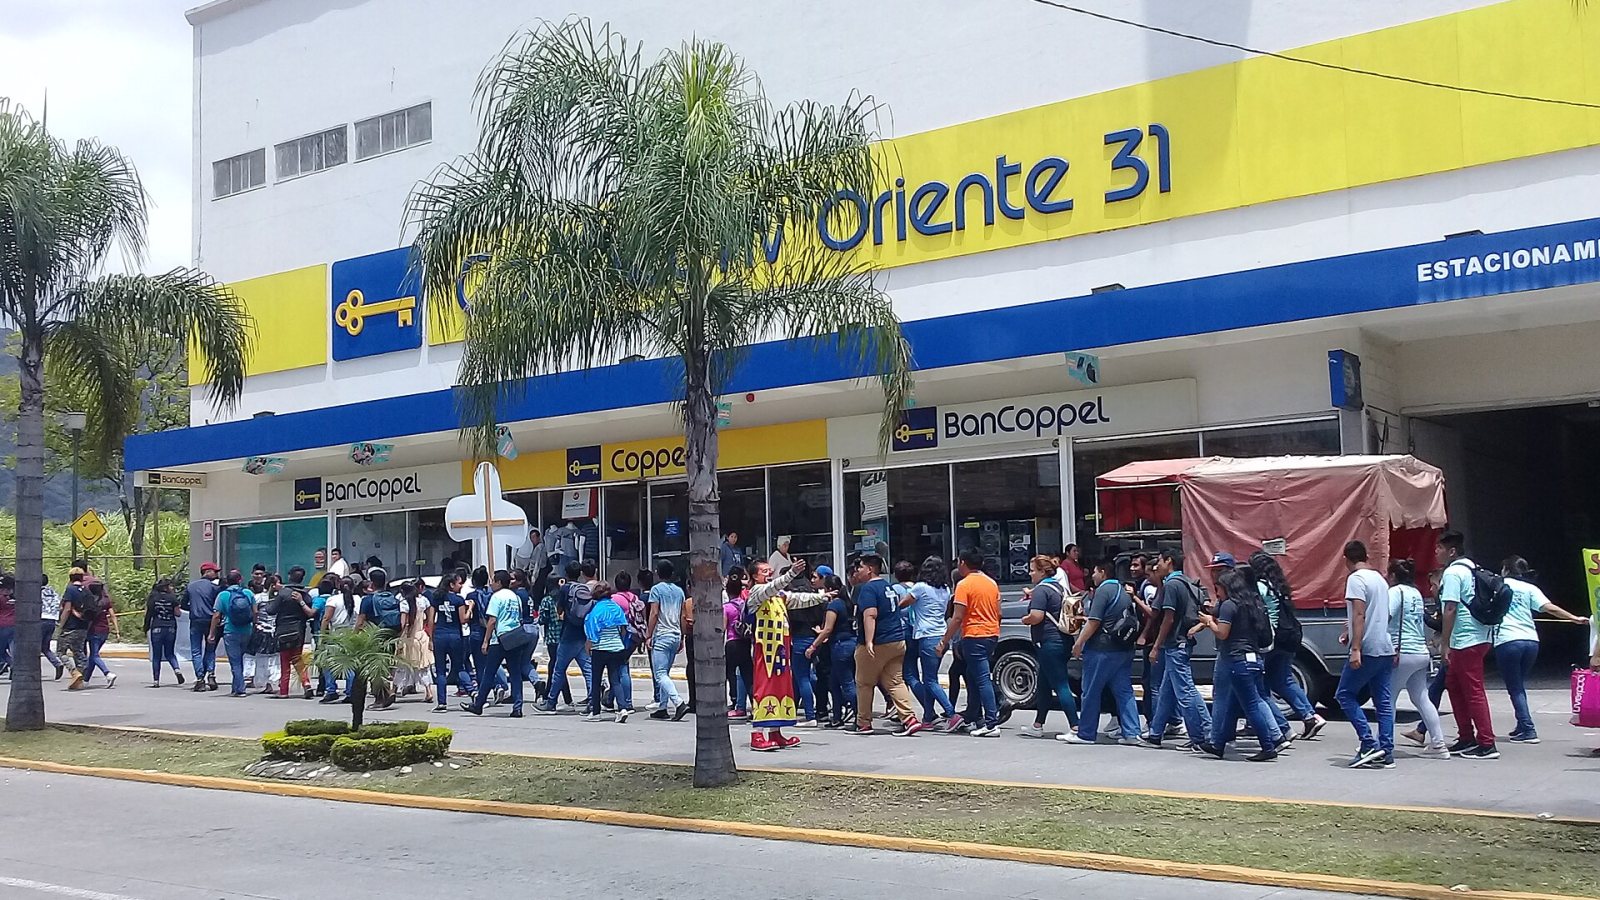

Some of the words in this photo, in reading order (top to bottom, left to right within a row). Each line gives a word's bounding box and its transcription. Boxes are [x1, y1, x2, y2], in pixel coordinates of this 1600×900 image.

[817, 155, 1074, 252] Oriente
[1104, 123, 1172, 204] 31
[1417, 240, 1600, 282] ESTACIONAM
[944, 396, 1110, 437] BanCoppel
[611, 446, 686, 478] Coppe
[162, 475, 203, 486] BanCoppel
[325, 472, 422, 503] BanCoppel
